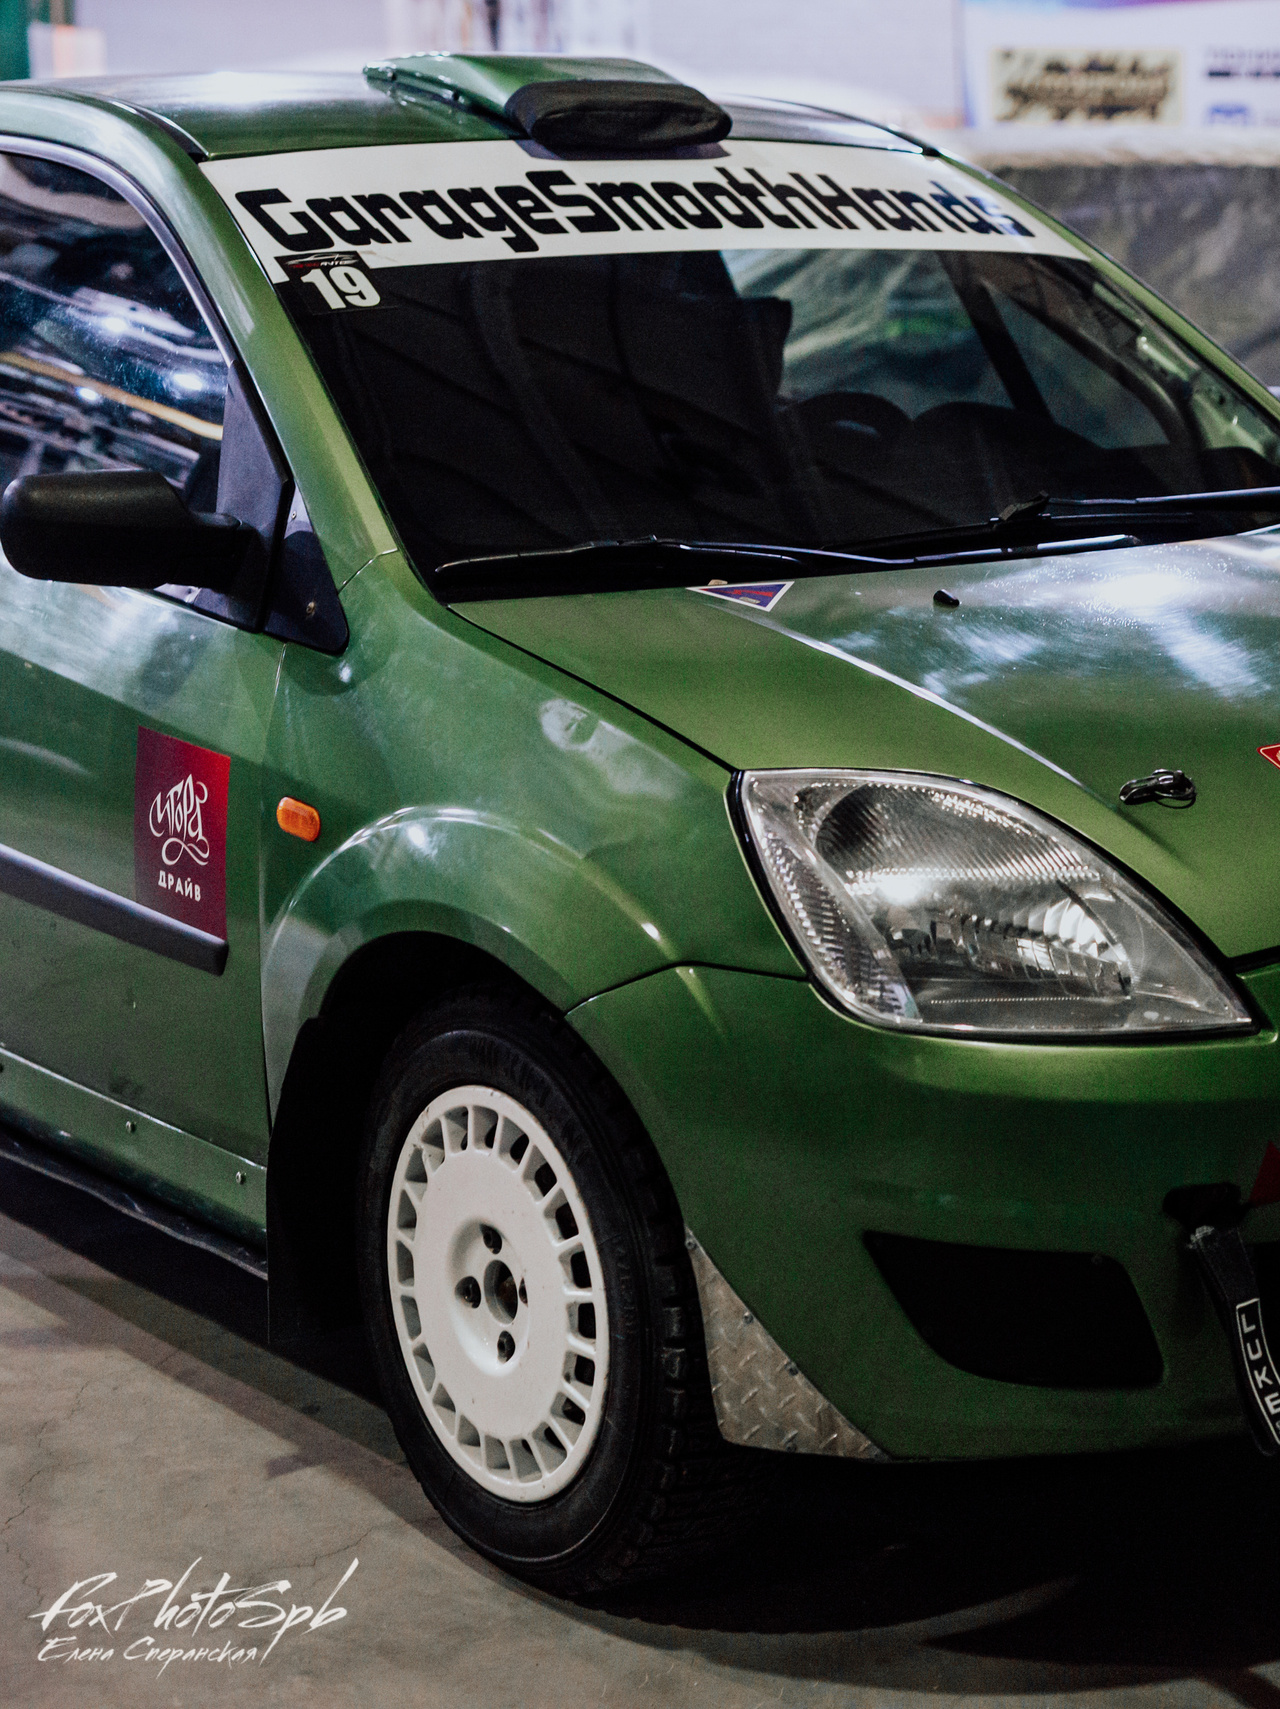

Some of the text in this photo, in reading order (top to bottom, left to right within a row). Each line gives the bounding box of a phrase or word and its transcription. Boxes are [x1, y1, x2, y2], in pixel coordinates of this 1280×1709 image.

[235, 166, 1036, 253] GarageSmoothHands
[300, 265, 381, 310] 19
[158, 869, 202, 902] ДРАЙВ
